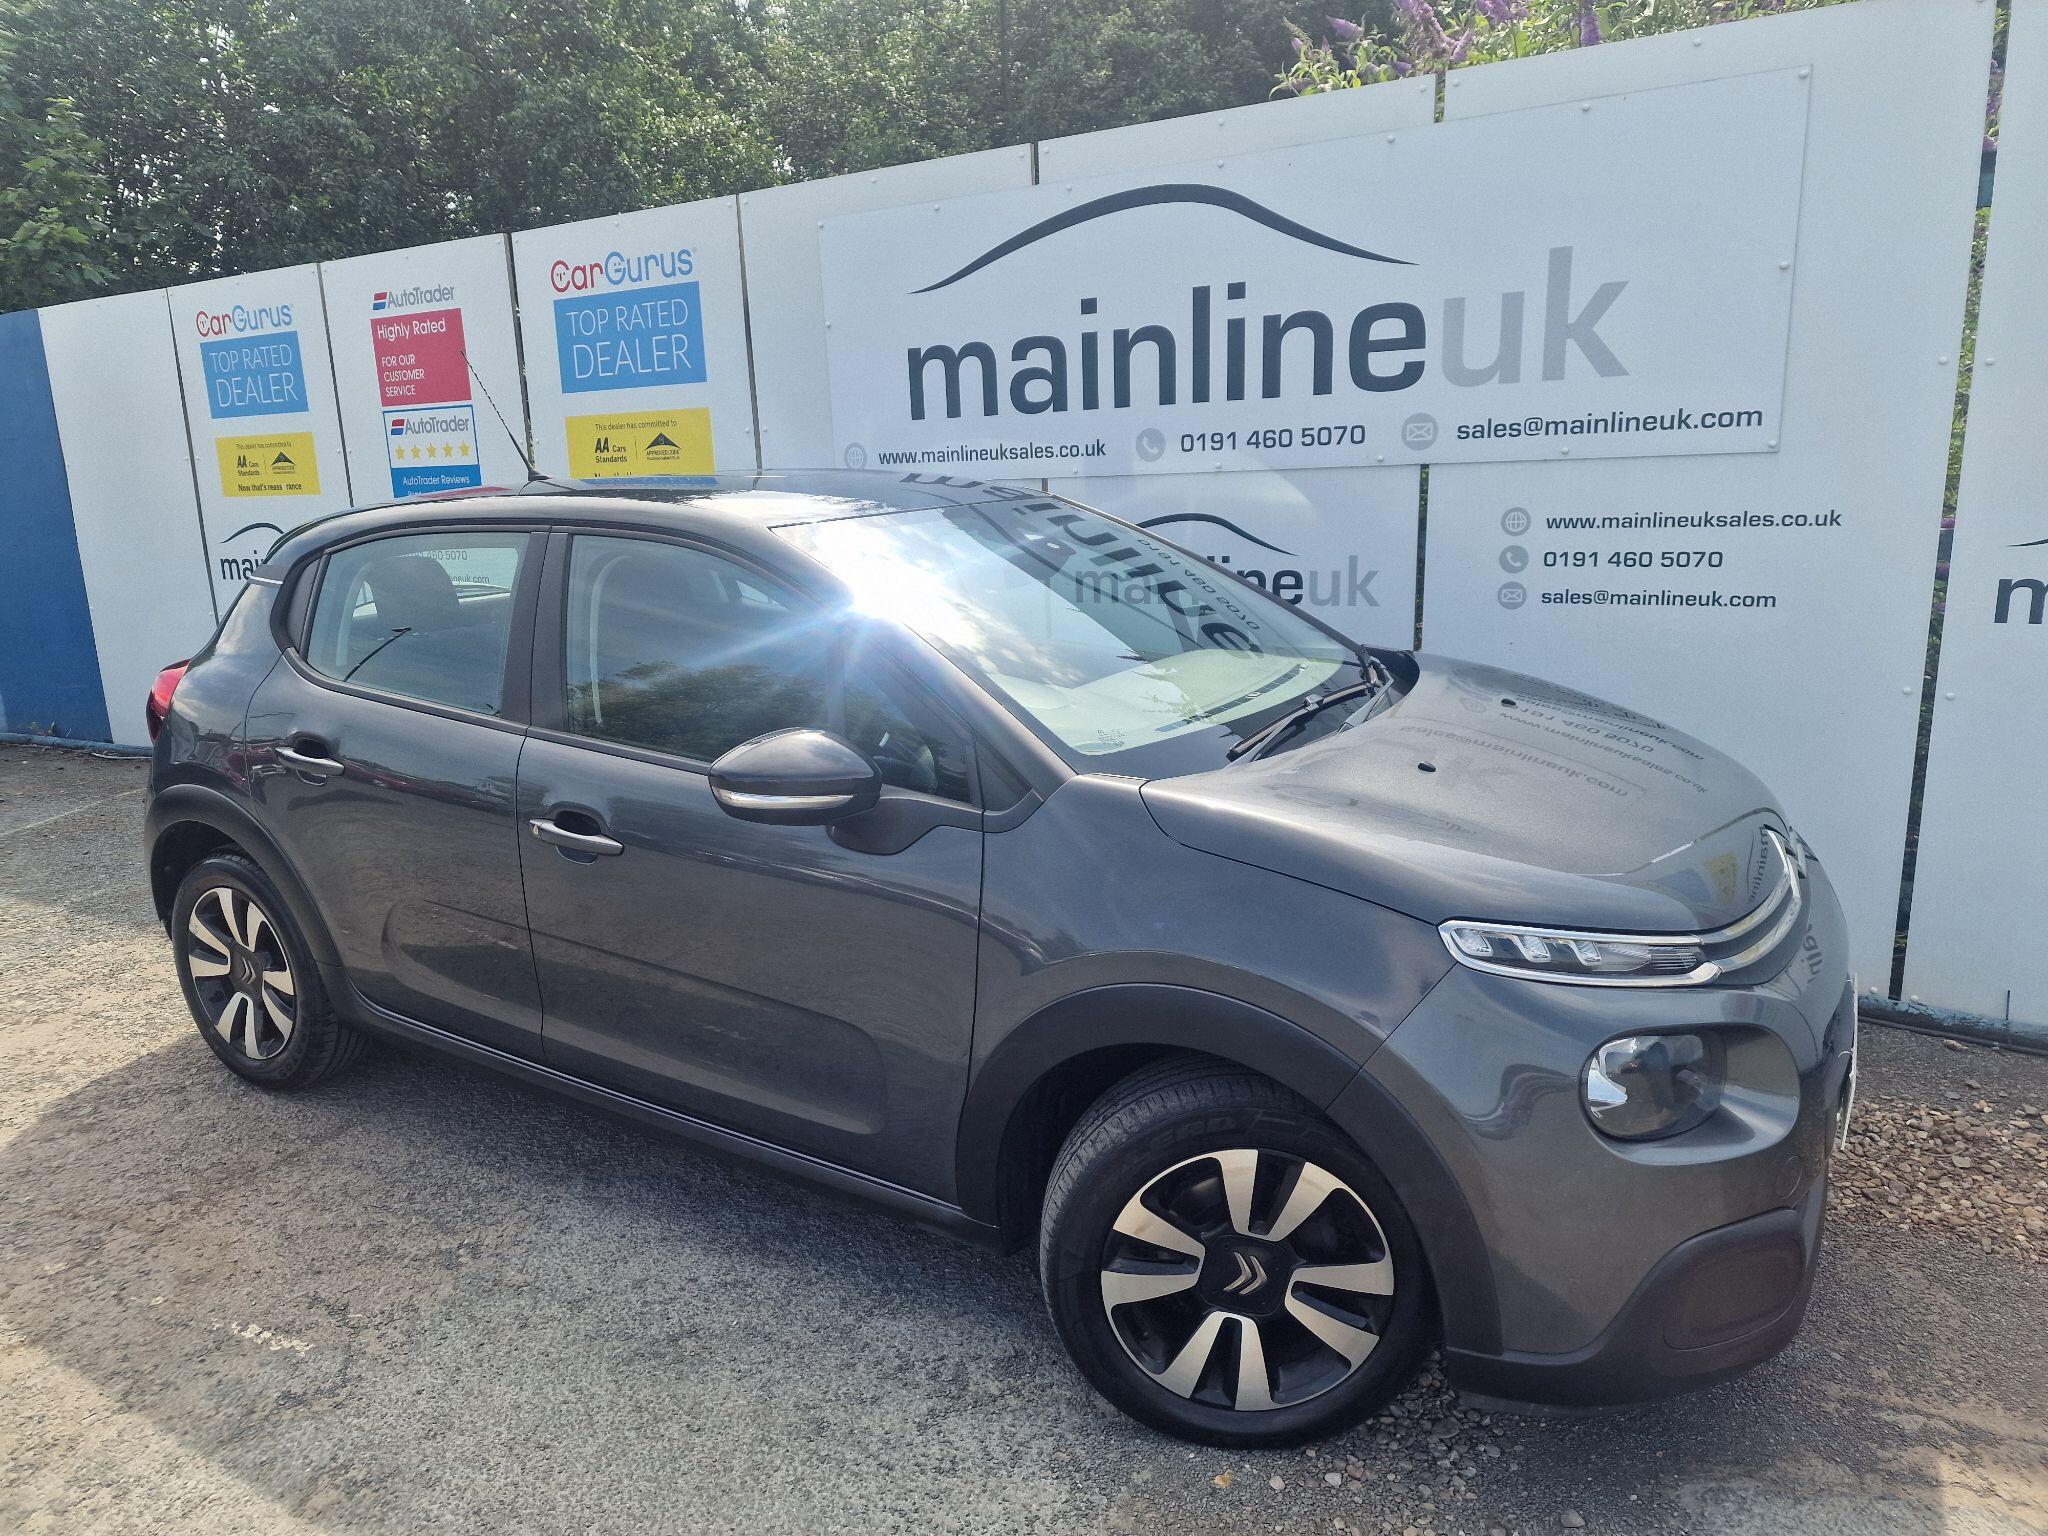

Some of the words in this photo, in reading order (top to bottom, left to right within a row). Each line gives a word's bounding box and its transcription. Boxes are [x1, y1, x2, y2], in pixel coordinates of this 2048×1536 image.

[551, 248, 693, 293] CarGurus
[388, 284, 455, 309] AutoTrader
[196, 304, 292, 337] CarGurus
[566, 308, 609, 337] TOP
[615, 298, 688, 332] RATED
[377, 322, 410, 341] Highly
[412, 317, 446, 335] Rated
[907, 245, 1630, 420] mainlineuk
[210, 350, 239, 373] TOP
[242, 344, 292, 370] RATED
[381, 355, 397, 367] FOR
[398, 353, 416, 366] OUR
[573, 333, 692, 379] DEALER
[383, 368, 425, 382] CUSTOMER
[216, 372, 298, 407] DEALER
[385, 384, 416, 397] SERVICE
[405, 415, 469, 435] AutoTrader
[595, 423, 607, 431] This
[607, 422, 626, 430] dealer
[626, 421, 637, 429] has
[638, 419, 670, 429] committed
[671, 419, 678, 427] to
[1457, 408, 1763, 440] sales@mainlineuk.com
[594, 437, 609, 453] AA
[612, 445, 627, 453] Cars
[1180, 431, 1238, 452] 0191
[1246, 428, 1293, 449] 460
[1300, 424, 1366, 447] 5070
[237, 454, 248, 468] AA
[595, 455, 628, 463] Standards
[878, 439, 1107, 465] www.mainlineuksales.co.uk
[238, 483, 250, 491] Now
[268, 483, 302, 491] reassrance
[403, 475, 440, 486] AutoTrader
[440, 474, 470, 485] Reviews
[1546, 509, 1842, 529] www.mainlineuksales.co.uk
[1543, 551, 1599, 568] 0191
[1607, 551, 1653, 568] 460
[1660, 551, 1724, 568] 5070
[1541, 589, 1777, 608] sales@mainlineuk.com
